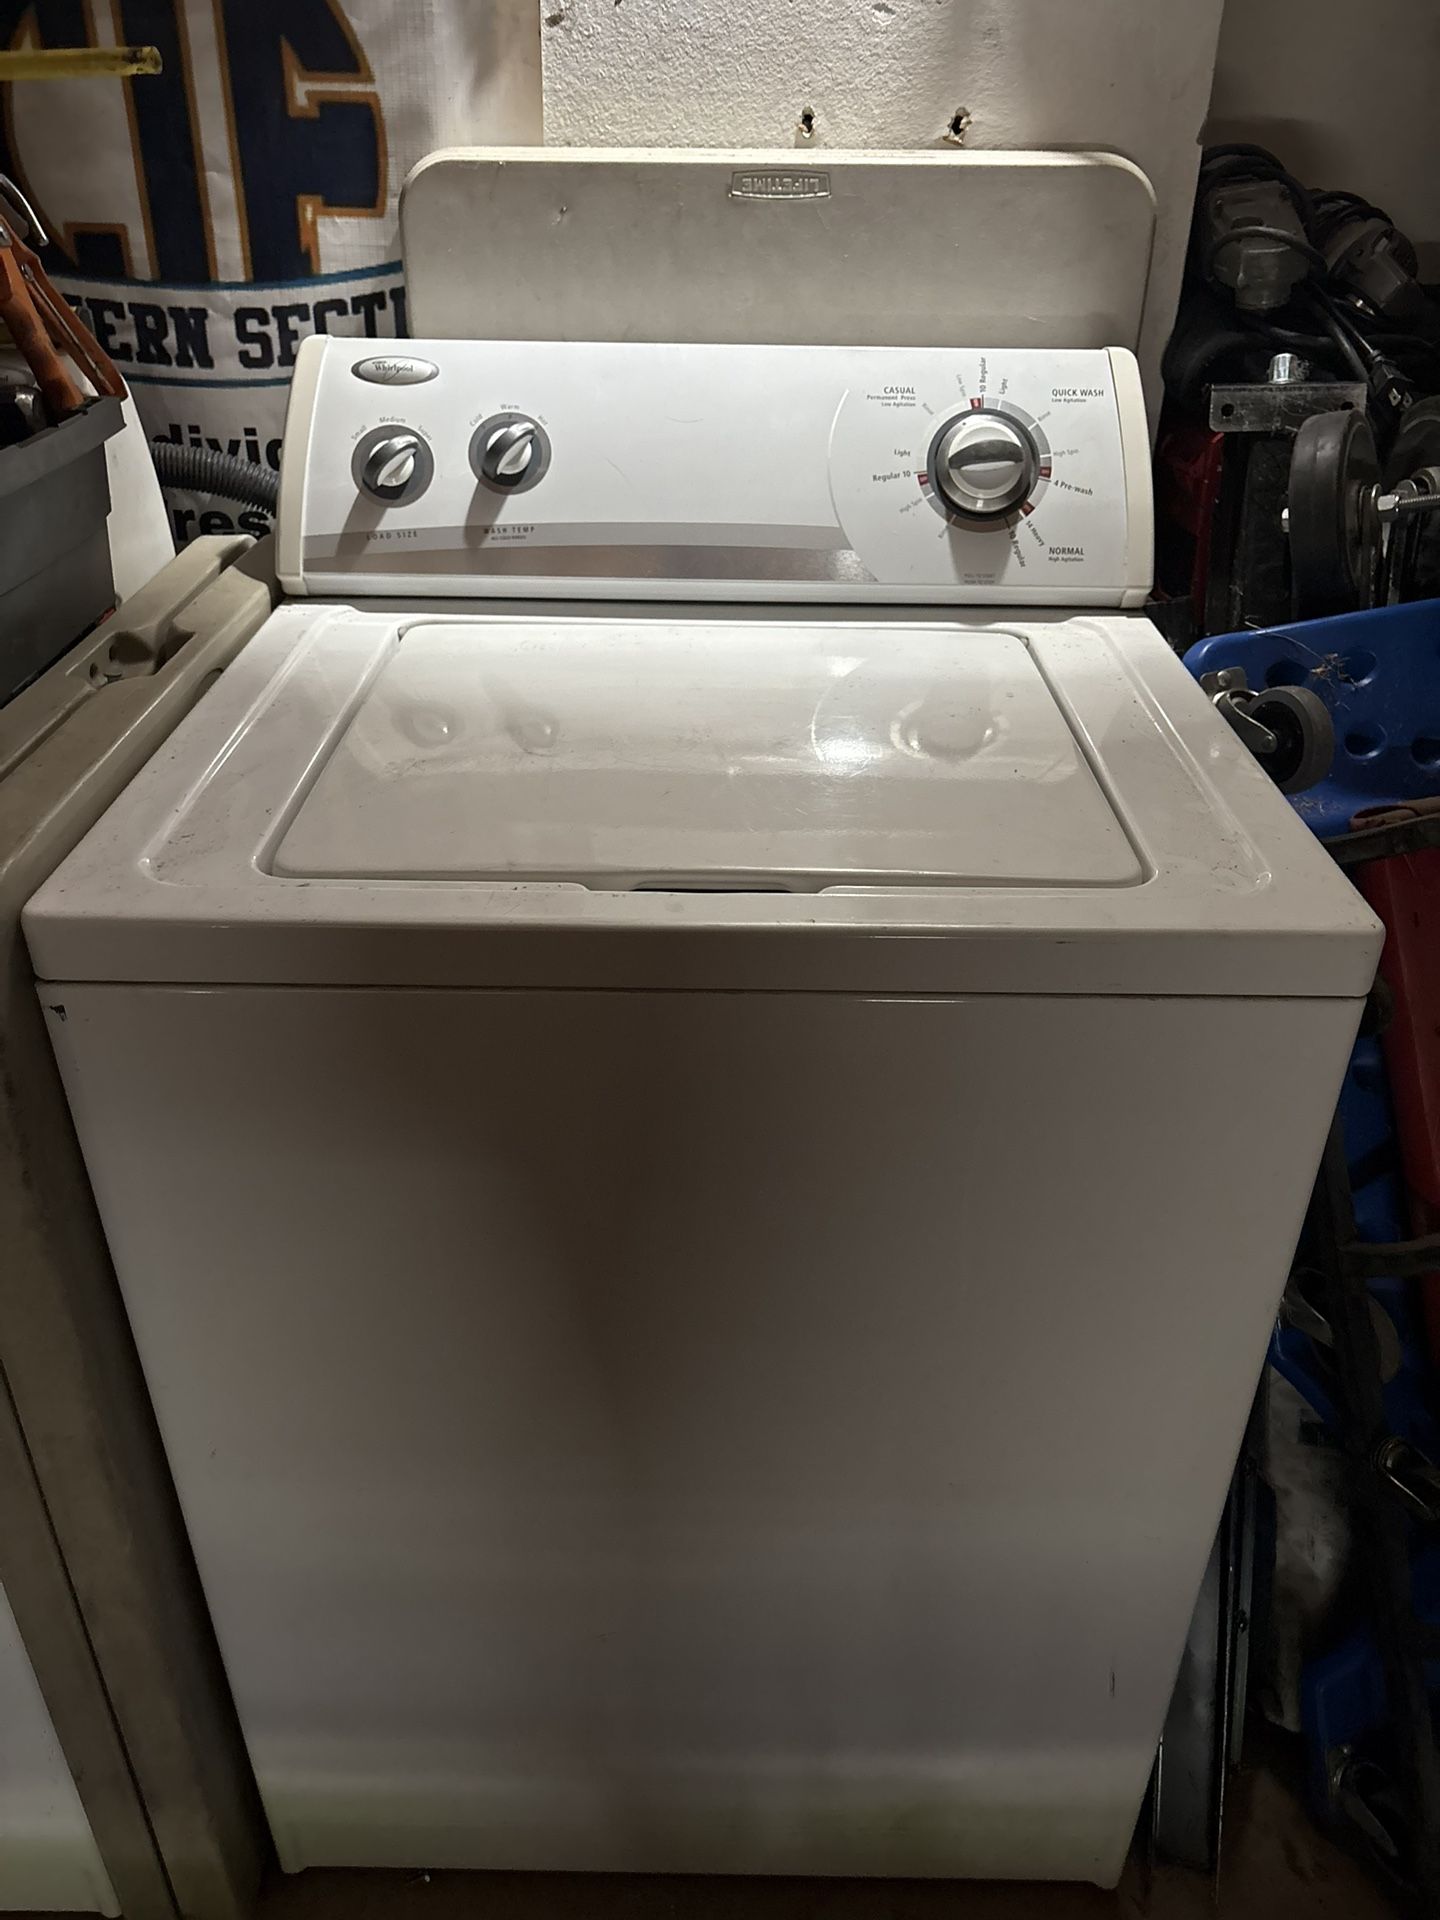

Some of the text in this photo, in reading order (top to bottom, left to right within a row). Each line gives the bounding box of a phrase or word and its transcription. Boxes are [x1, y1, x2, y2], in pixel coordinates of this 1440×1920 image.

[742, 177, 819, 192] LIFETIME
[62, 294, 215, 369] ERN
[375, 363, 414, 373] Whirlpool
[979, 357, 988, 393] 10 Regular
[883, 386, 916, 394] CASUAL
[998, 378, 1008, 395] Light
[1051, 388, 1104, 397] QUICK WASH
[379, 416, 406, 424] Medium
[351, 425, 367, 440] Small
[894, 449, 911, 457] Light
[872, 470, 911, 482] Regular 10
[1060, 480, 1094, 496] Pre-wash
[366, 530, 418, 541] LOAD SIZE
[483, 526, 535, 535] WASH TEMP
[1030, 526, 1045, 547] Heavy
[1012, 539, 1026, 568] Regular
[1048, 547, 1084, 556] NORMAL
